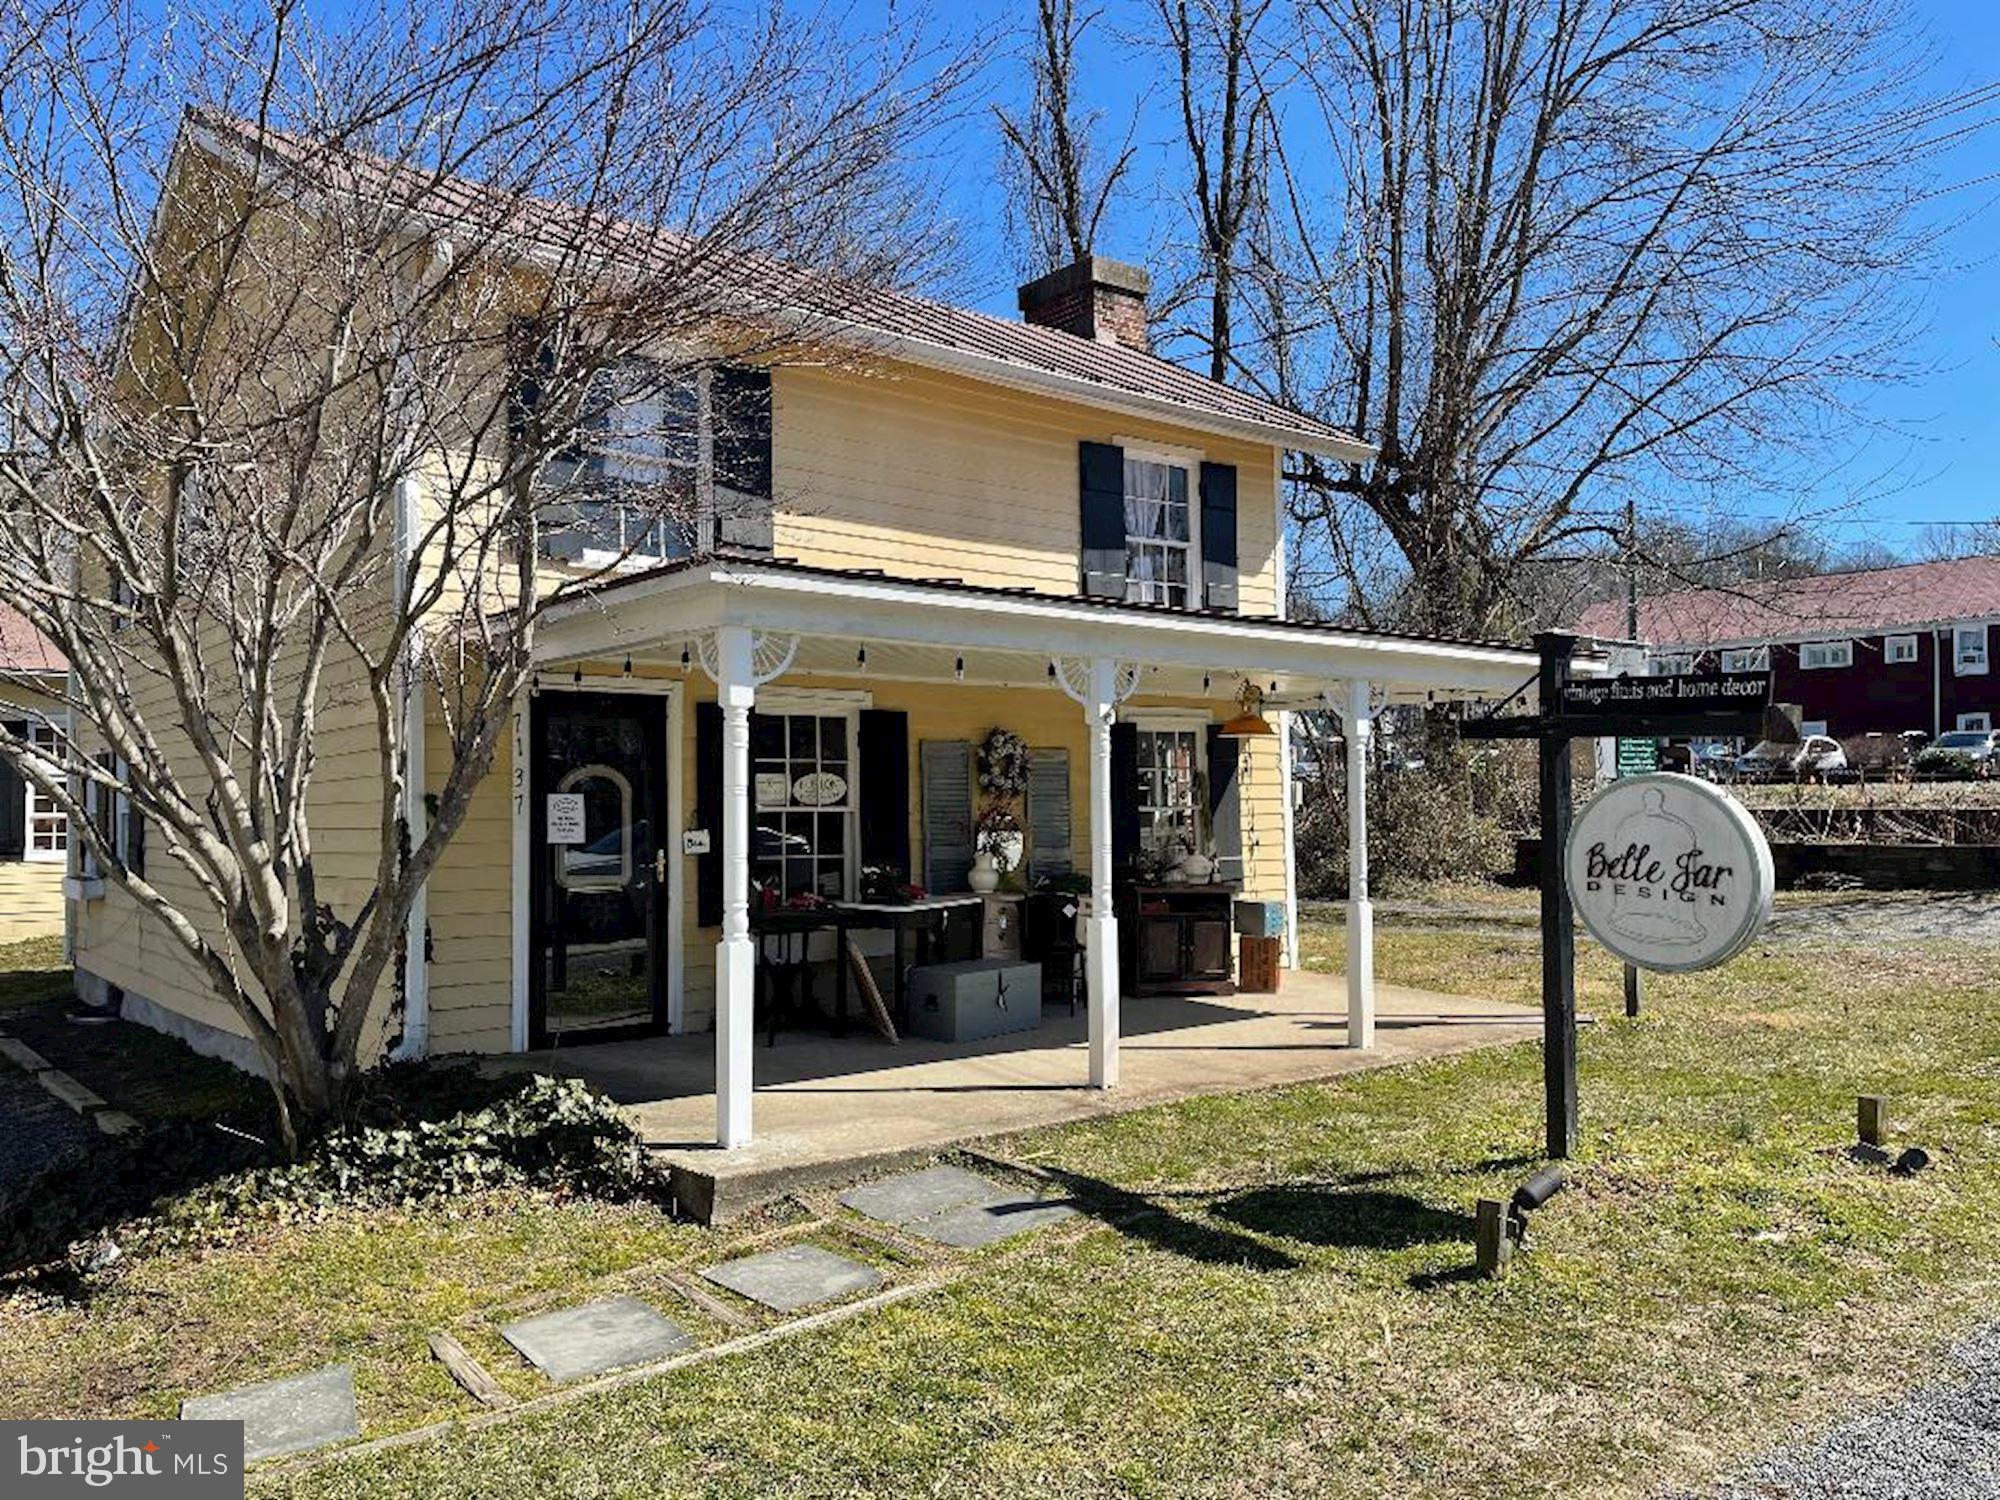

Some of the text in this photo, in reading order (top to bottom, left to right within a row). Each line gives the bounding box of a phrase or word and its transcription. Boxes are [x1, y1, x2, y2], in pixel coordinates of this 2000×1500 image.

[1648, 679, 1674, 698] and
[1678, 678, 1718, 698] home
[1721, 677, 1767, 696] decor
[513, 713, 523, 815] 7137
[1586, 842, 1733, 893] Belle Jar
[1587, 881, 1725, 906] DESIGN
